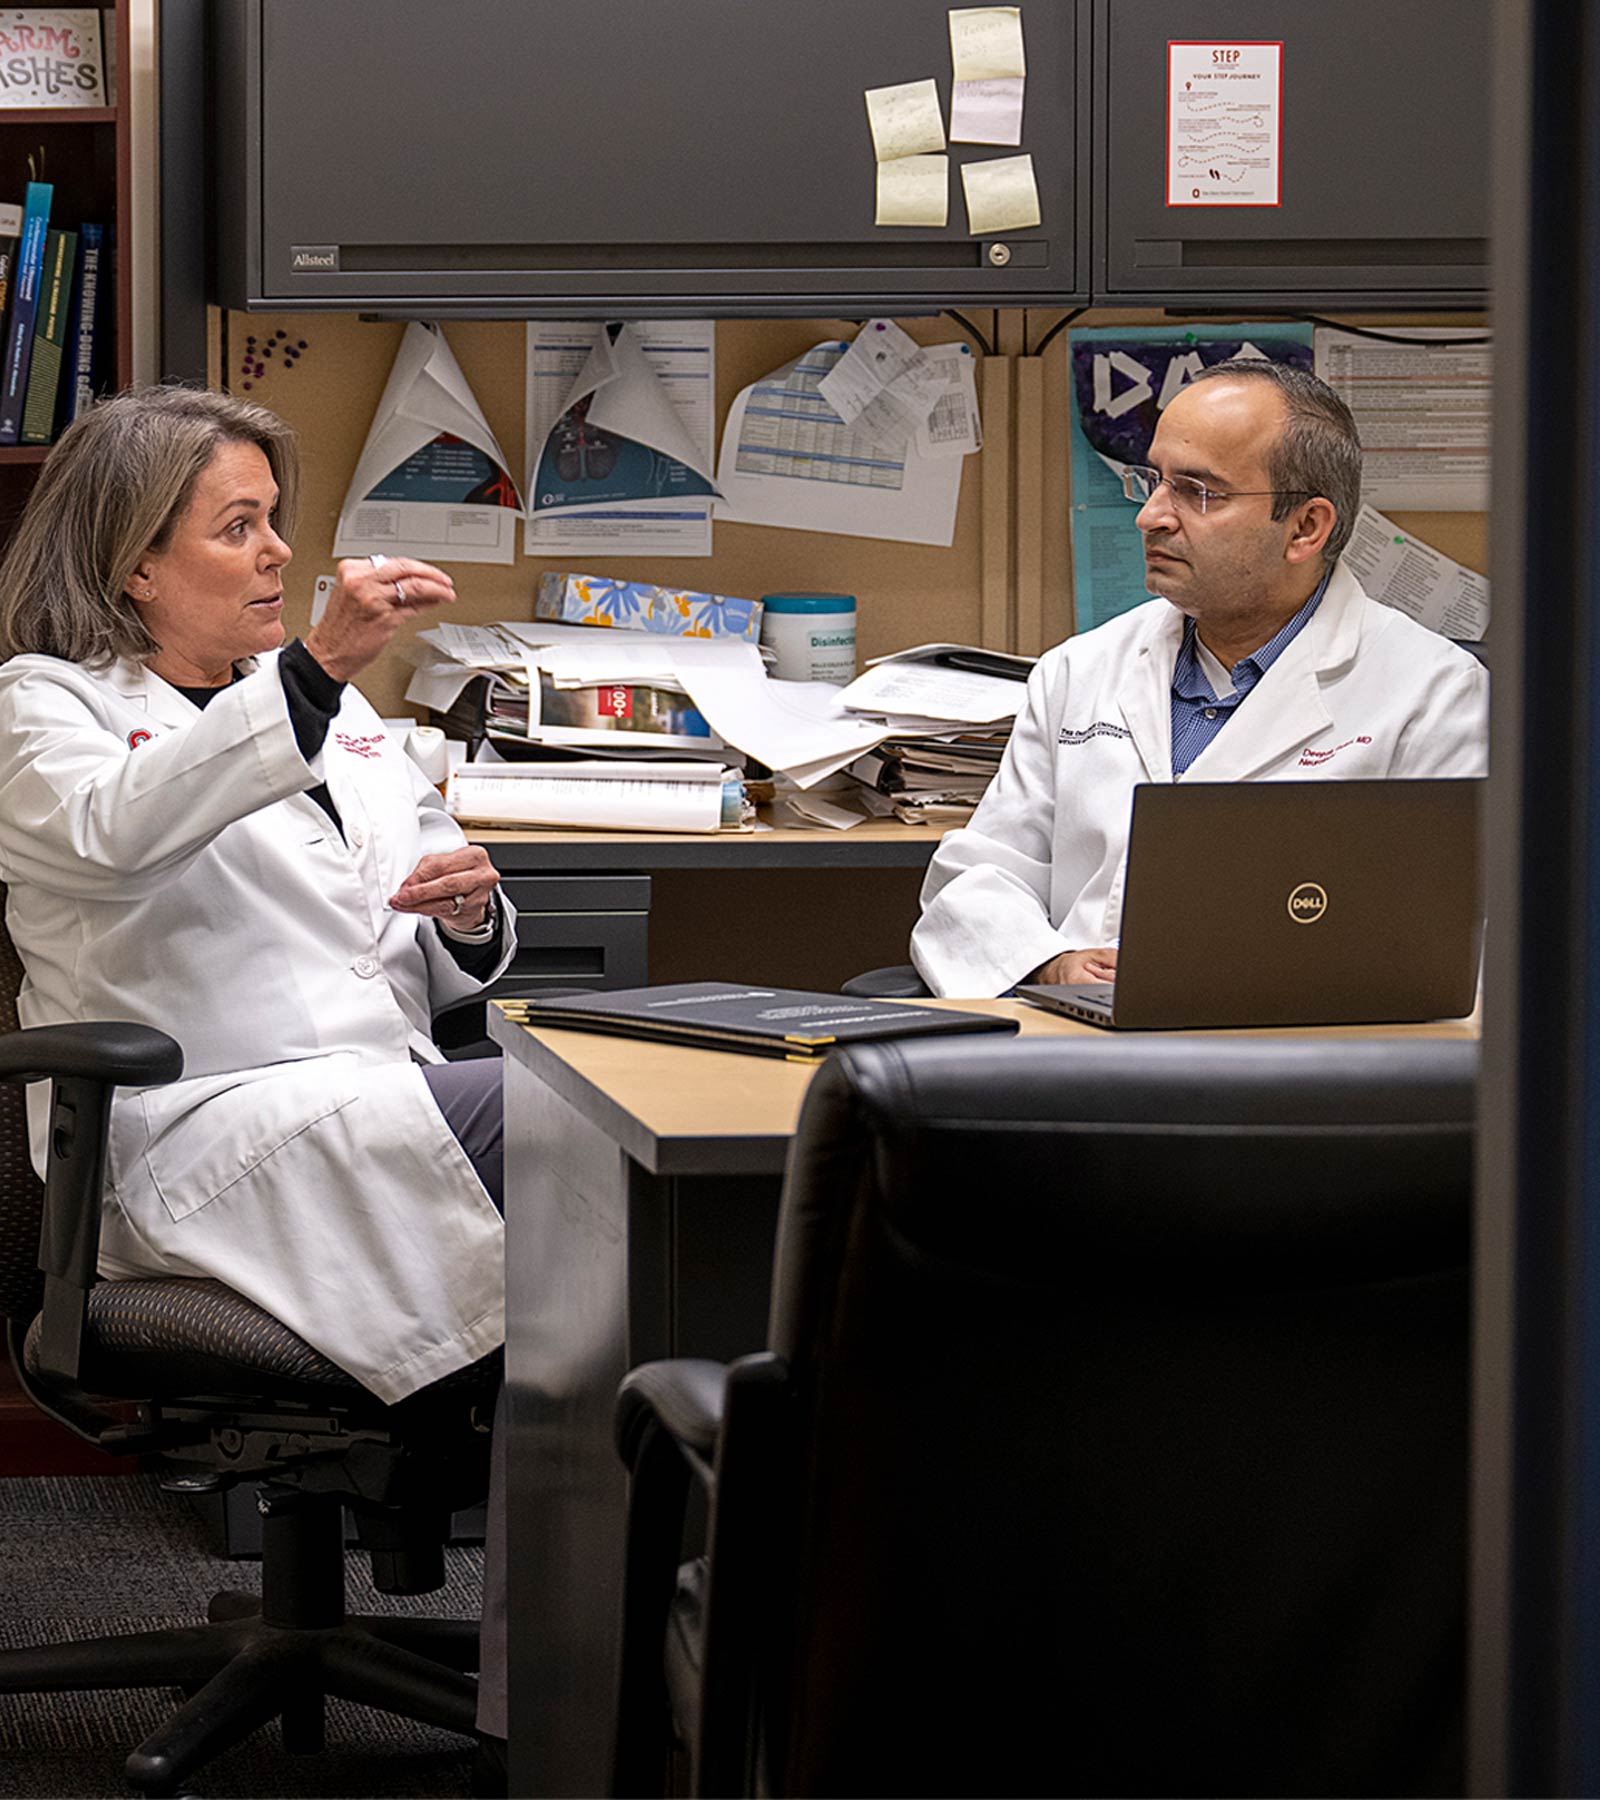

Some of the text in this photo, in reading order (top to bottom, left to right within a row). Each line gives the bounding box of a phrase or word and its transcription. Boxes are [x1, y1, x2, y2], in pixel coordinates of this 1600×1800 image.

[1212, 49, 1241, 63] STEP
[84, 249, 99, 270] THE
[78, 272, 98, 373] KNOWING-DOING
[1293, 897, 1322, 910] DELL
